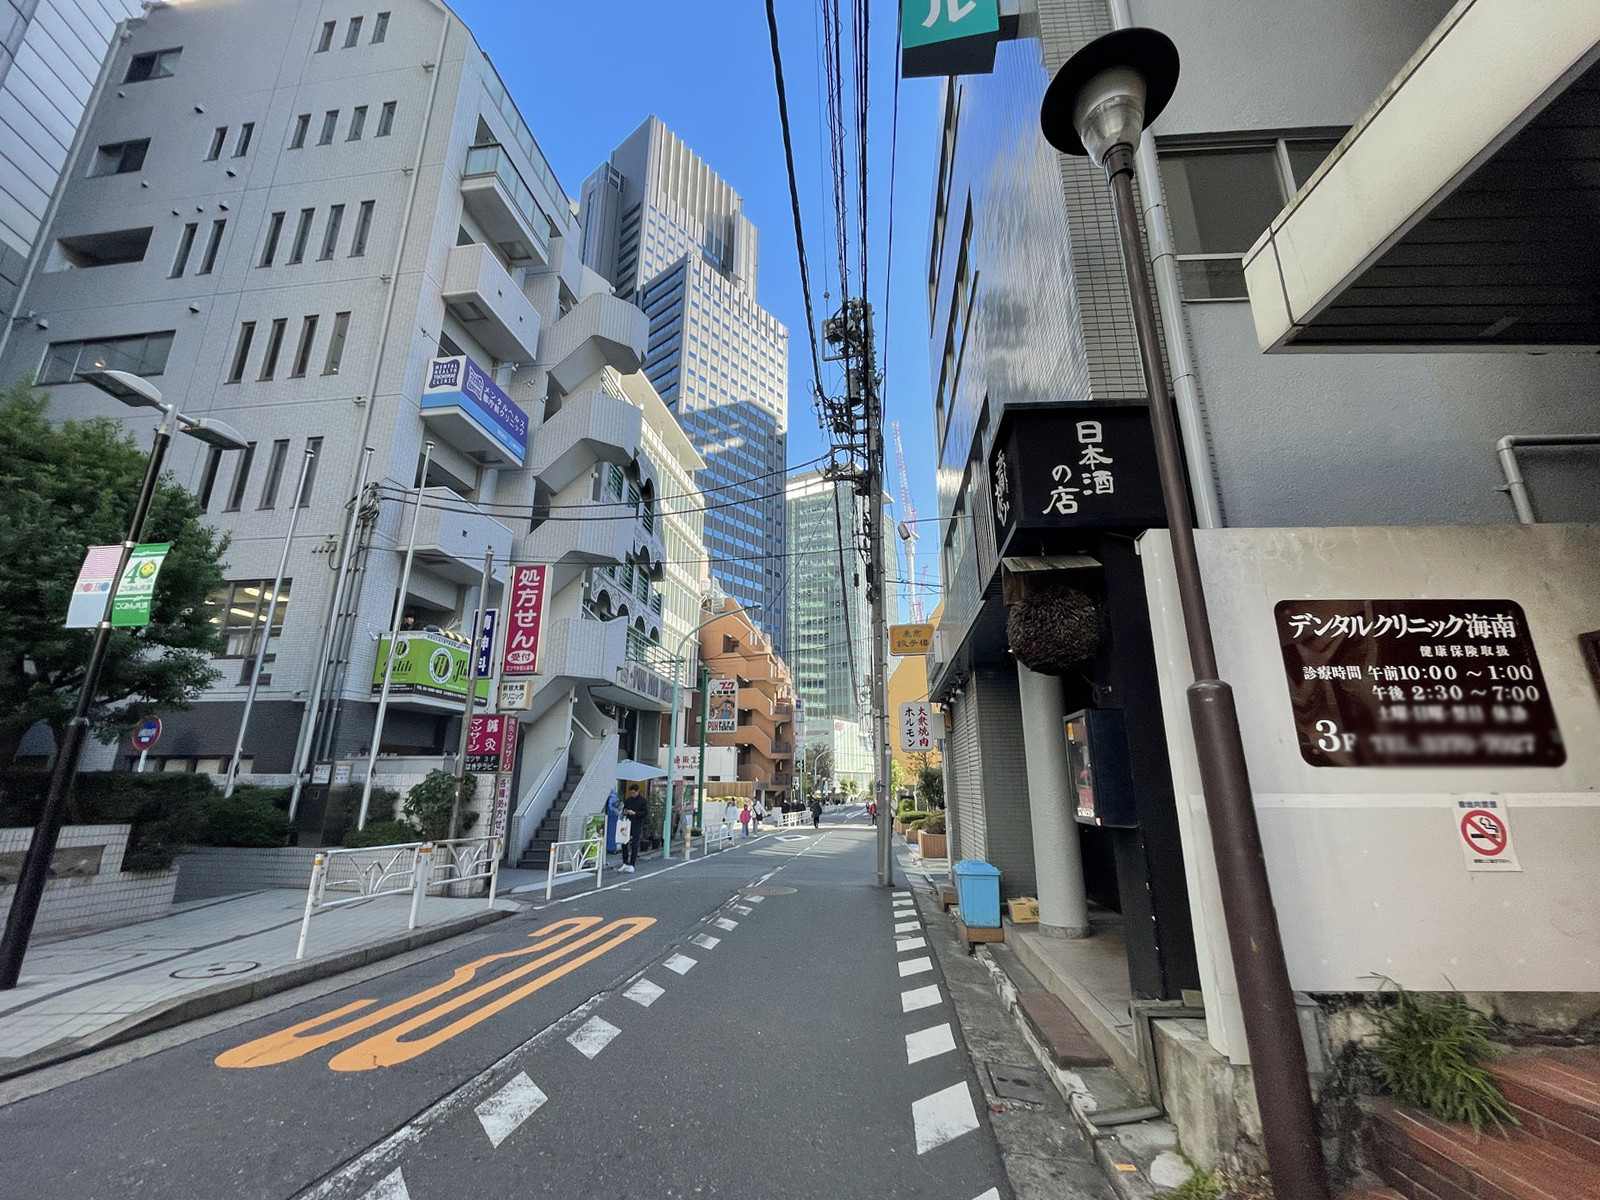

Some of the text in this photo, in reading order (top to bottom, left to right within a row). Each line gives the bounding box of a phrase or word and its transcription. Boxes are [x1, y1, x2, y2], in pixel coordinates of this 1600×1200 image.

[1075, 420, 1114, 496] 日本酒
[1042, 464, 1080, 515] の店
[511, 569, 541, 649] 処方せん
[1288, 613, 1517, 639] デンタルクリニック海南
[510, 653, 531, 662] 受付
[1303, 666, 1362, 681] 診療時間
[1487, 665, 1534, 681] 1:00
[502, 692, 524, 700] クリニック
[1372, 685, 1406, 702] 午後
[1412, 685, 1463, 701] 2:30
[1494, 685, 1539, 702] 7:00
[467, 718, 483, 752] マッサージ
[905, 706, 915, 748] ホルモン
[918, 706, 929, 747] 大衆焼肉
[1315, 719, 1357, 753] 3F
